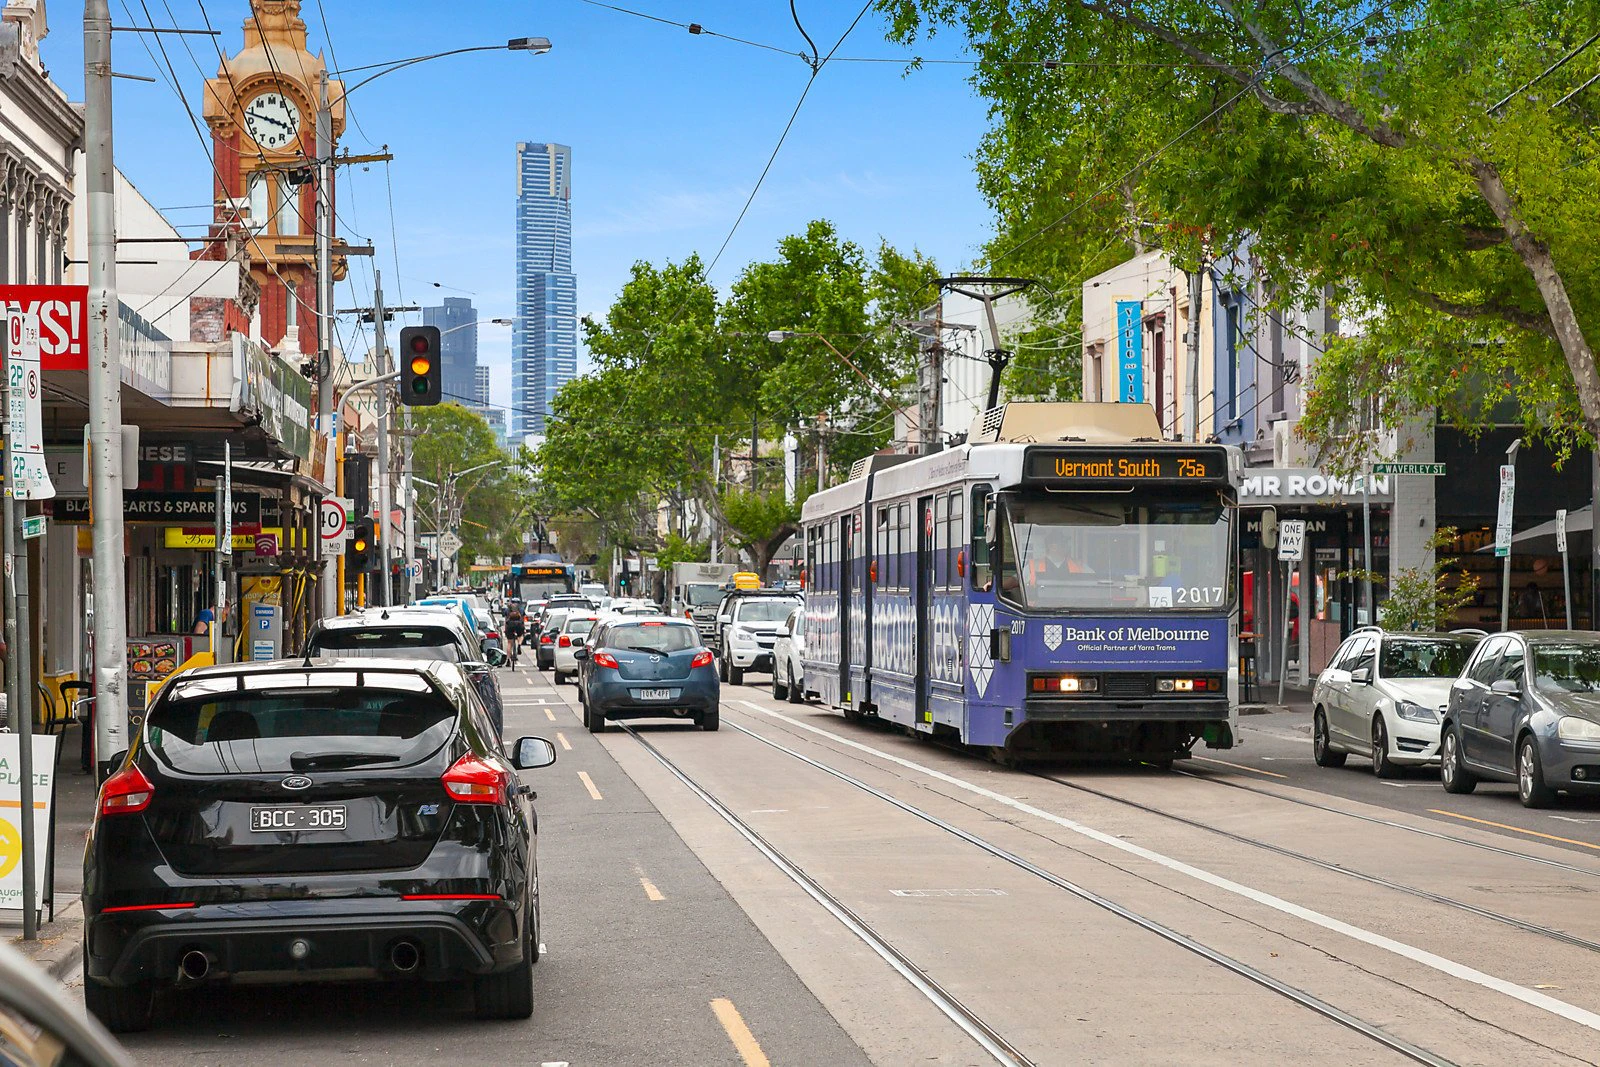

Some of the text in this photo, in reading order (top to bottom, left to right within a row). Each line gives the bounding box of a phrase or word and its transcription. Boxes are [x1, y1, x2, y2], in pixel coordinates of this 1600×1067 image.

[11, 365, 23, 386] 2P
[13, 456, 25, 478] 2P
[1055, 458, 1205, 477] Vermont South 75a
[1385, 464, 1443, 474] WAVERLEY ST
[1240, 475, 1281, 496] MR
[164, 501, 173, 513] &
[176, 501, 247, 514] SPARRWS
[1284, 525, 1301, 534] ONE
[1282, 536, 1302, 546] WAY
[1176, 587, 1222, 604] 2017
[1011, 620, 1025, 635] 2017
[1066, 627, 1209, 641] Bank of Melbourne
[260, 809, 344, 828] BCC 305
